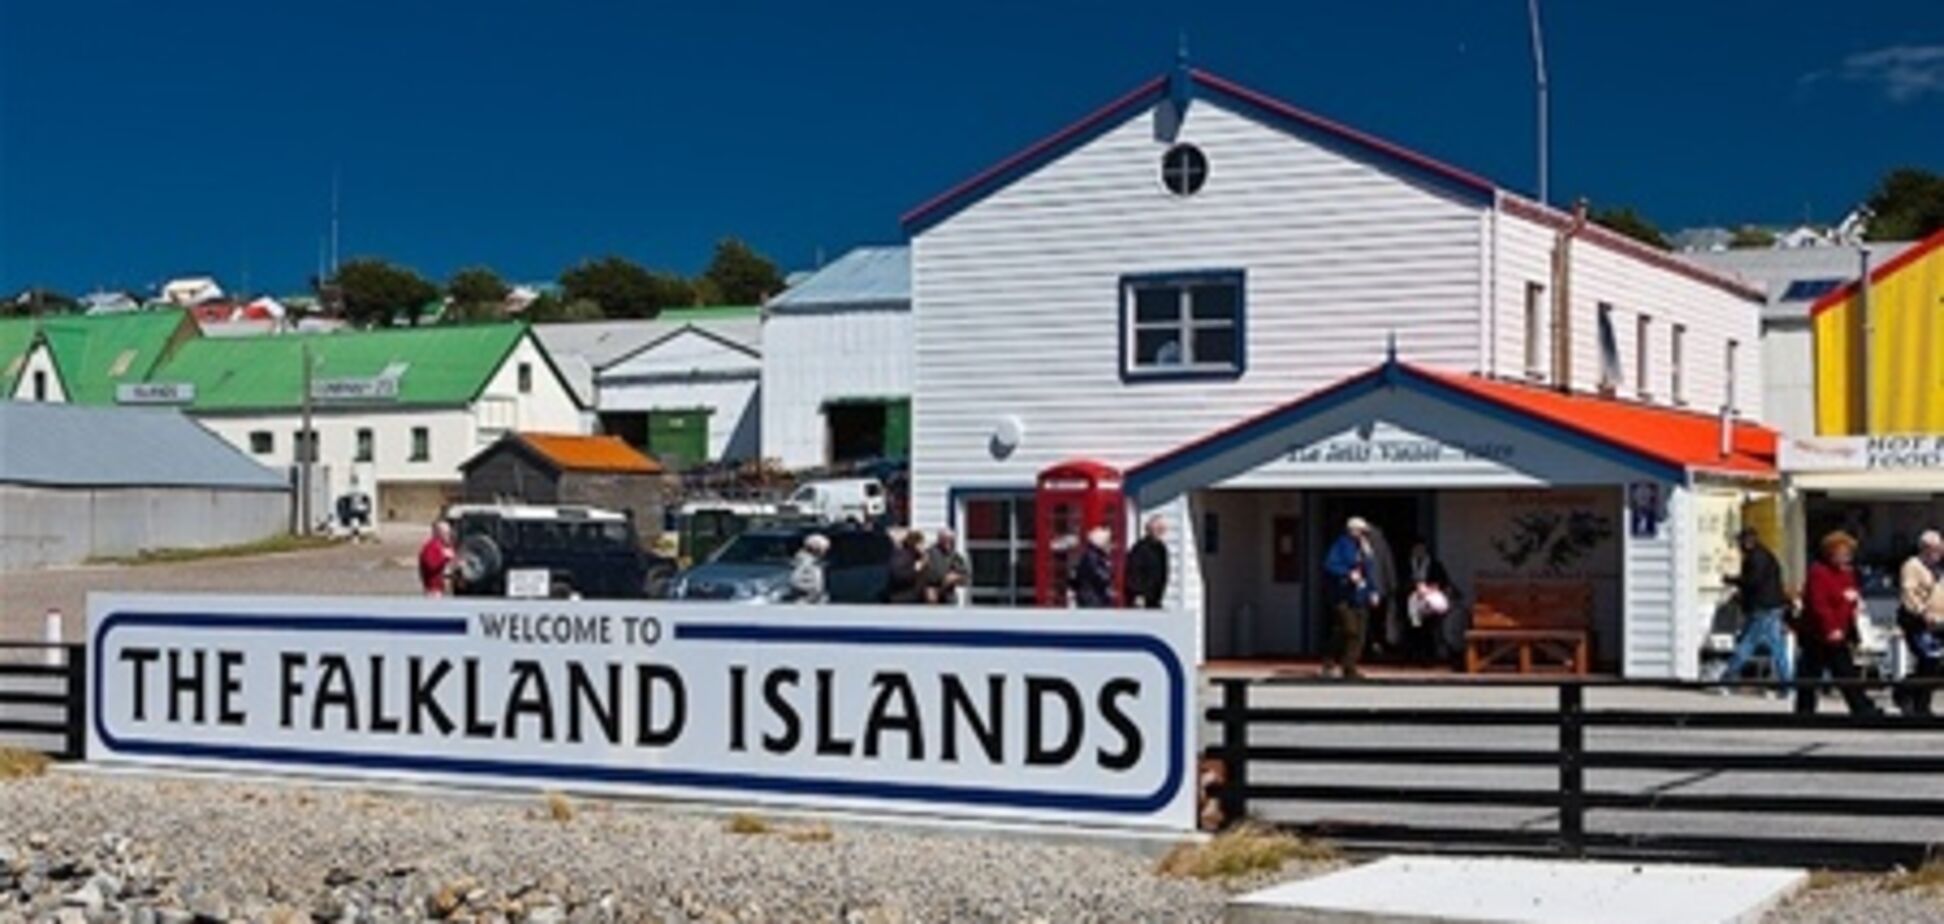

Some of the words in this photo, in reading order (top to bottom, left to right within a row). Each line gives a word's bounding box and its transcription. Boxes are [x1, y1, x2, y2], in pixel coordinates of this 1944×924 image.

[479, 612, 612, 645] WELCOME
[622, 616, 662, 646] TO
[119, 647, 247, 725] THE
[279, 651, 687, 747] FALKLAND
[728, 666, 1144, 771] ISLANDS
